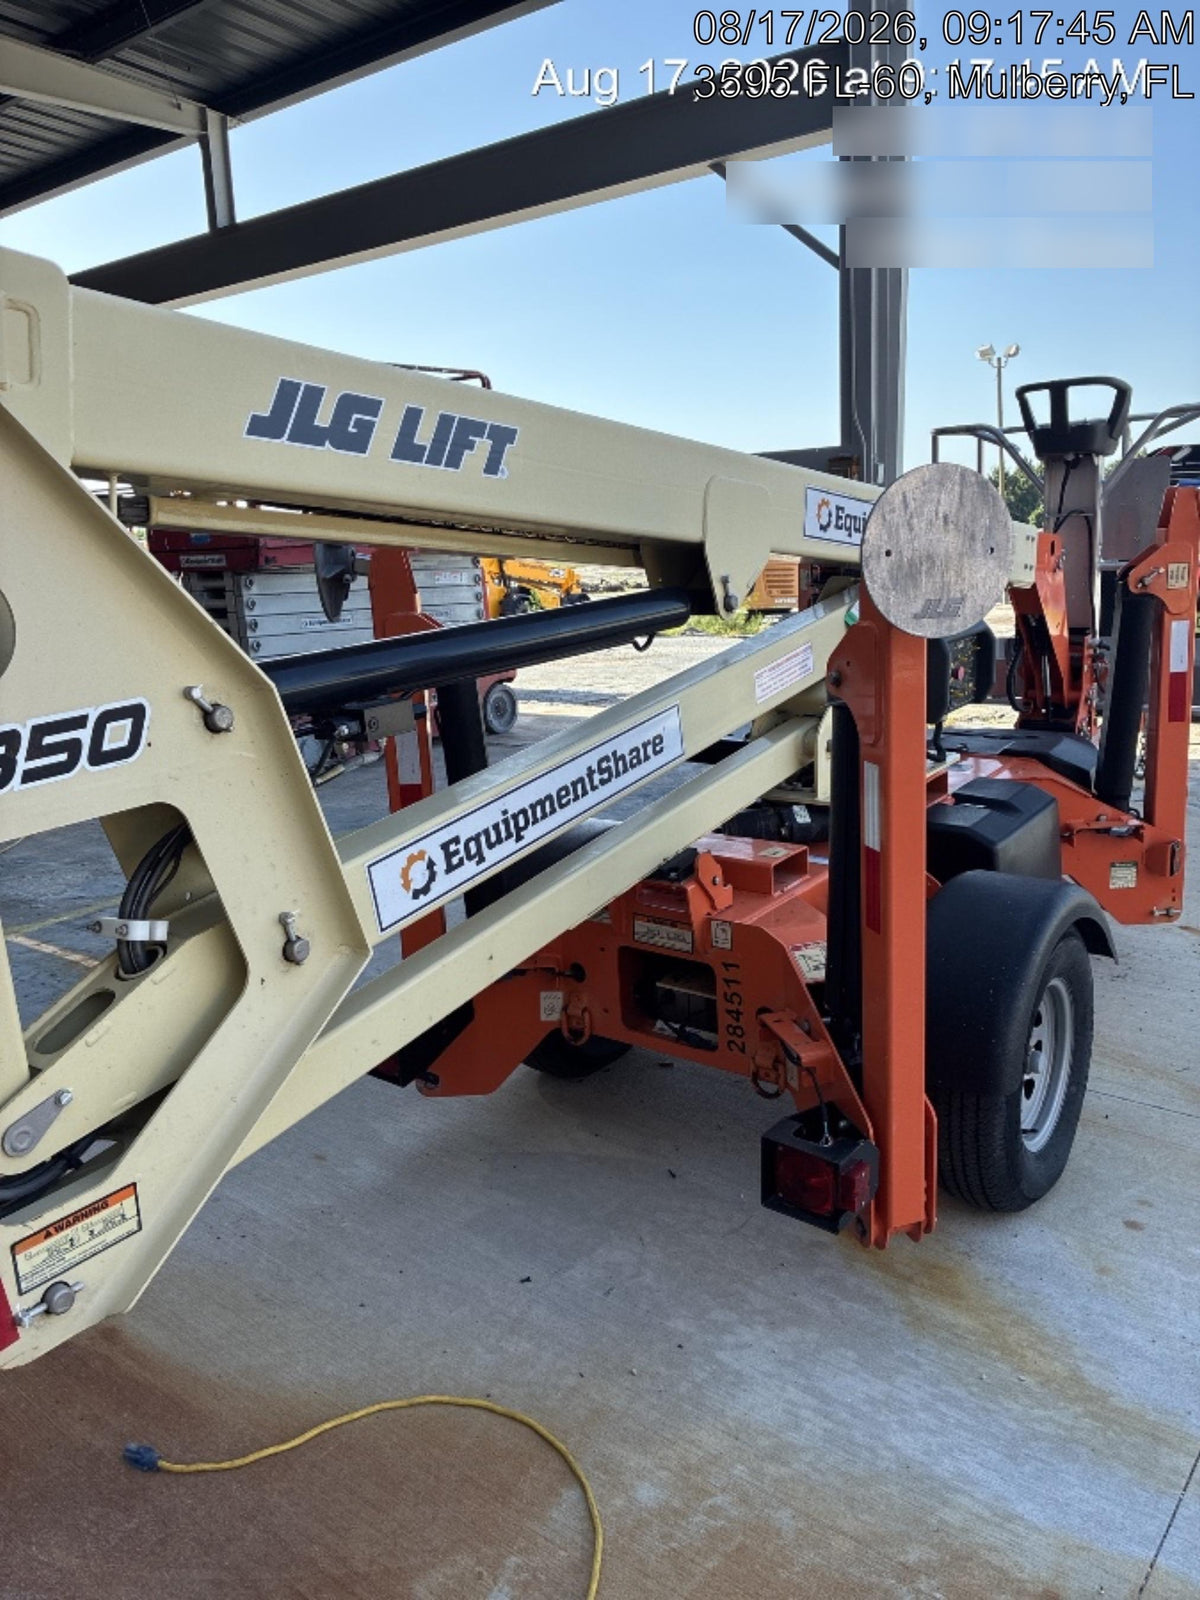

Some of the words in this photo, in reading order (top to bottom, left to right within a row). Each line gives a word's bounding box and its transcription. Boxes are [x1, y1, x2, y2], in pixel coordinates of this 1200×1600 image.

[243, 377, 386, 457] JLG
[390, 404, 519, 479] LIFT
[439, 732, 664, 875] EquipmentShare
[722, 961, 747, 1055] 284511
[53, 1199, 110, 1234] WARNING
